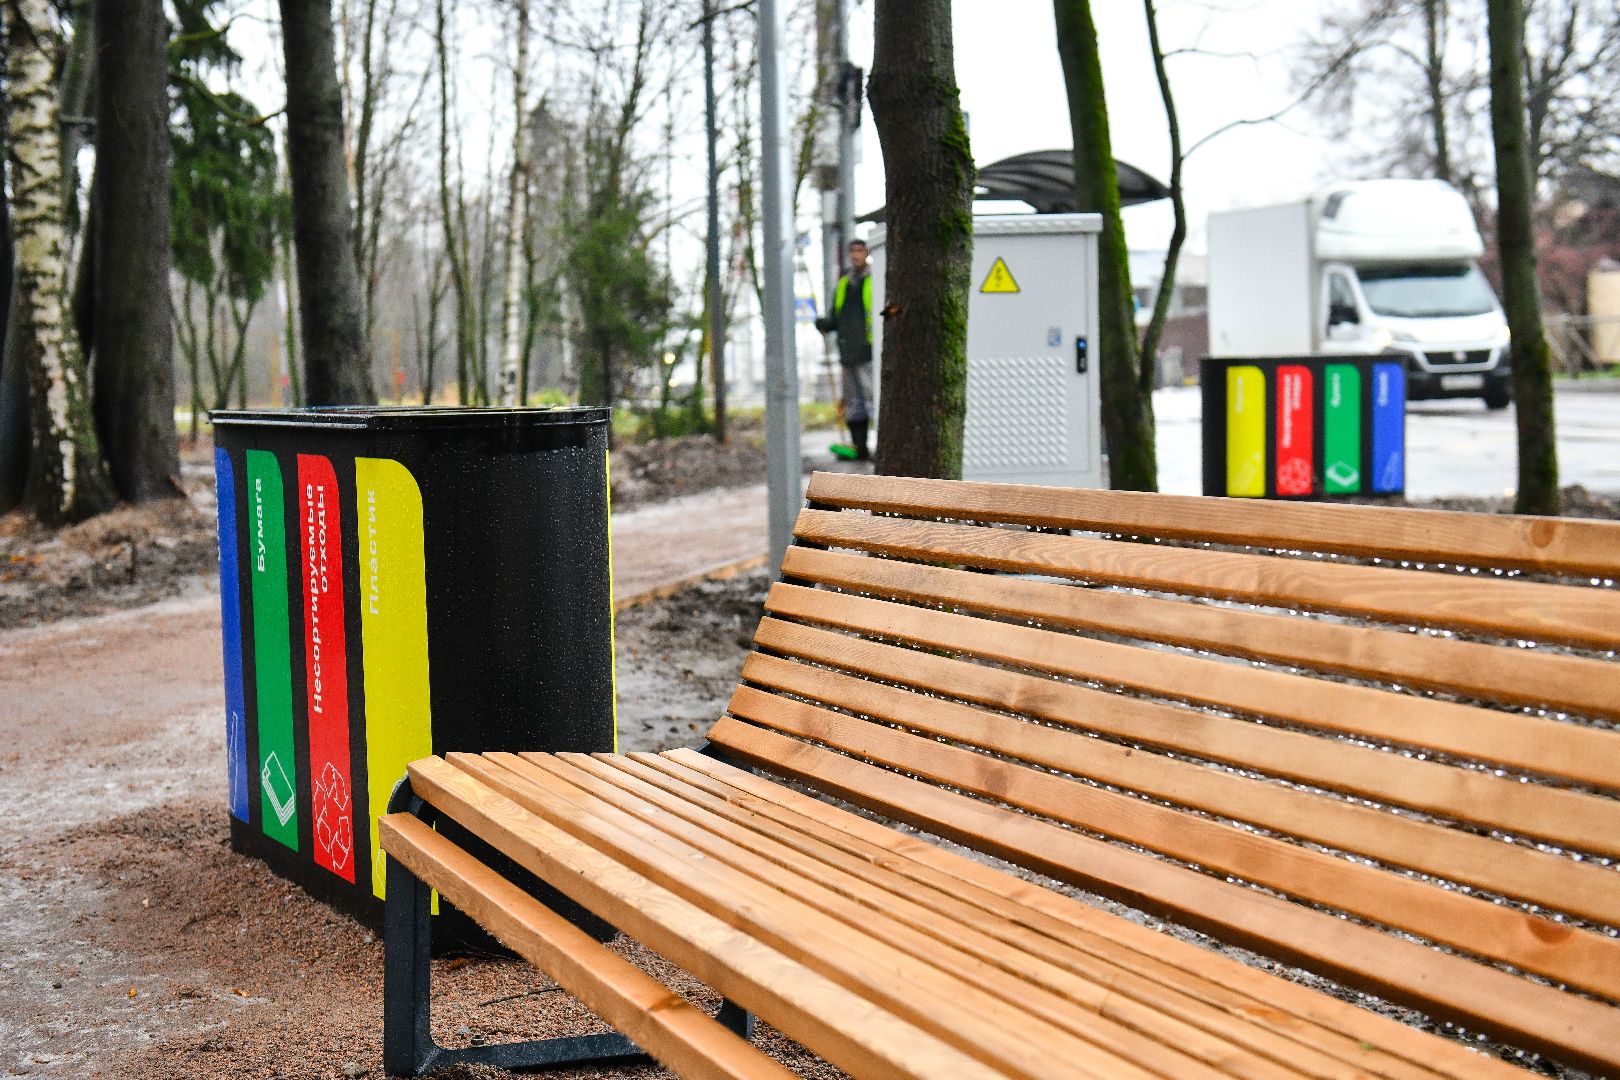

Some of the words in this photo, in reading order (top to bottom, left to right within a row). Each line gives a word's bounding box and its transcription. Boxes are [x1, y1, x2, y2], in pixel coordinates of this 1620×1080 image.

[255, 478, 266, 573] Бумага
[316, 485, 328, 593] отходы
[367, 488, 379, 615] Пластик
[306, 483, 323, 714] Несортируемые
